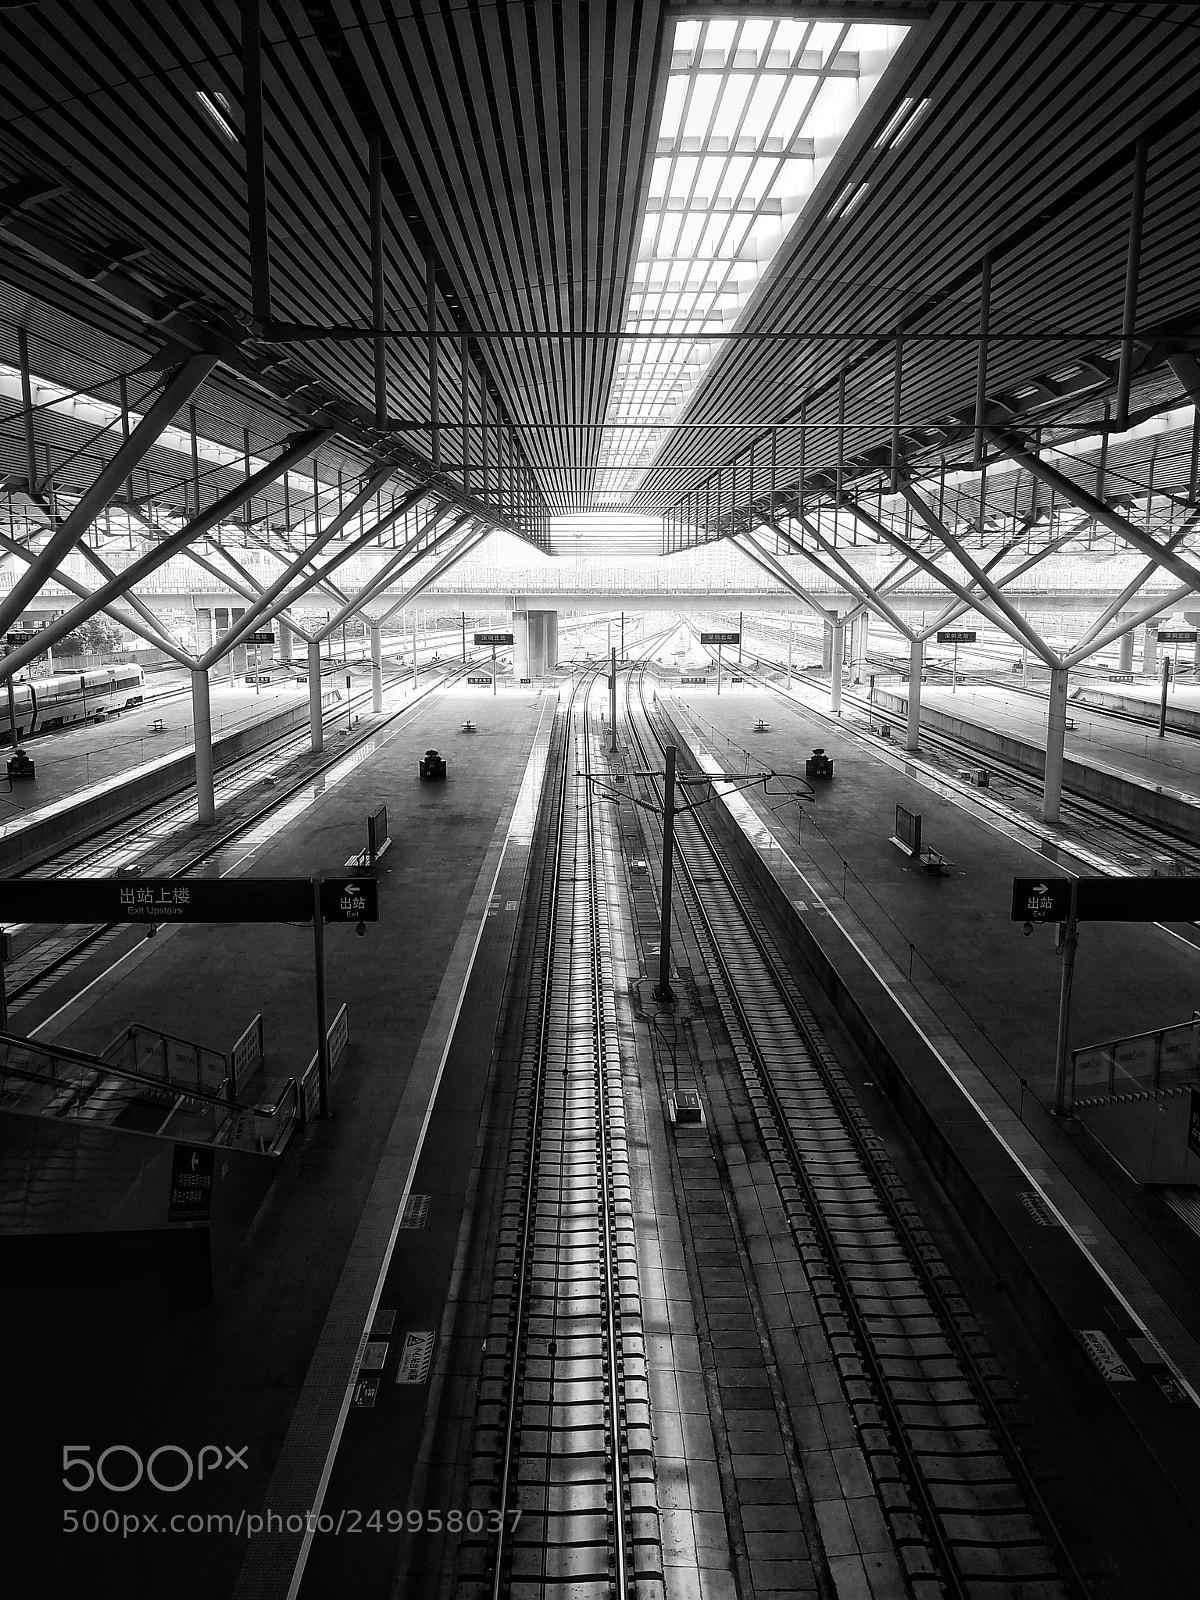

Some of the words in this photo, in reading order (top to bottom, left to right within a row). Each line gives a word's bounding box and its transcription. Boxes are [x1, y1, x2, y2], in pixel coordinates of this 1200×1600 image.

[120, 887, 190, 904] 出站上楼
[340, 897, 365, 910] 出站
[1027, 896, 1053, 909] 出站
[127, 906, 144, 915] Exit
[147, 906, 183, 916] Upstairs
